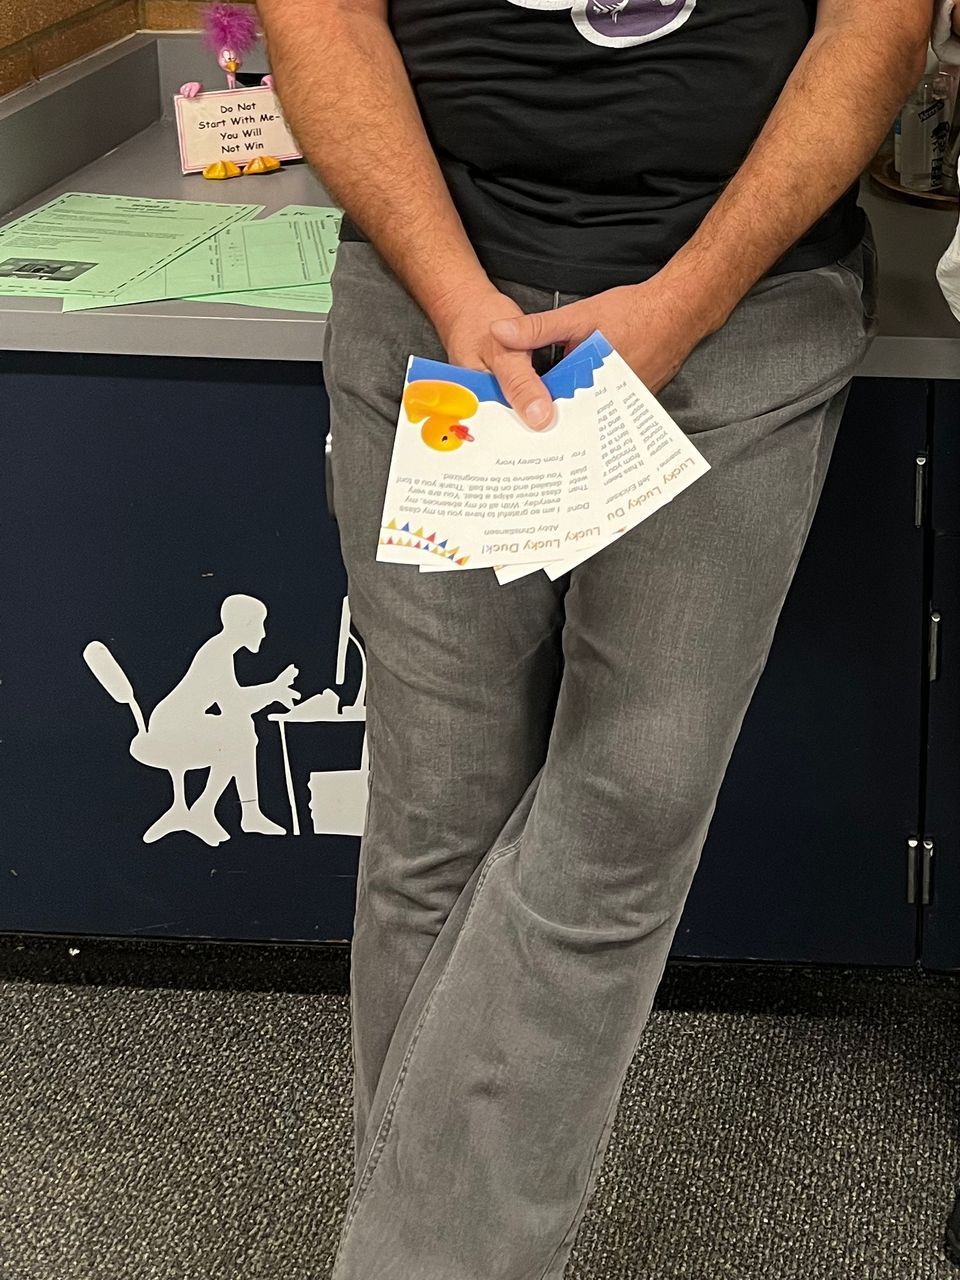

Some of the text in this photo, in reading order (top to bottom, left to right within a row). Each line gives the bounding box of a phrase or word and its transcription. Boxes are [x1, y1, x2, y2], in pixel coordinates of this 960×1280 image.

[237, 102, 256, 111] Not
[198, 120, 226, 130] Start
[231, 116, 255, 126] With
[220, 128, 261, 140] You Will
[221, 142, 264, 154] Not Win
[608, 453, 640, 473] from you
[663, 457, 695, 484] Lucky
[422, 480, 437, 488] you
[439, 482, 463, 491] Thank
[408, 486, 426, 495] very
[405, 495, 419, 503] my
[628, 486, 662, 510] Lucky
[497, 509, 528, 517] grateful
[537, 524, 558, 532] Abby
[565, 527, 600, 542] Lucky
[481, 538, 560, 554] Lucky Duck!
